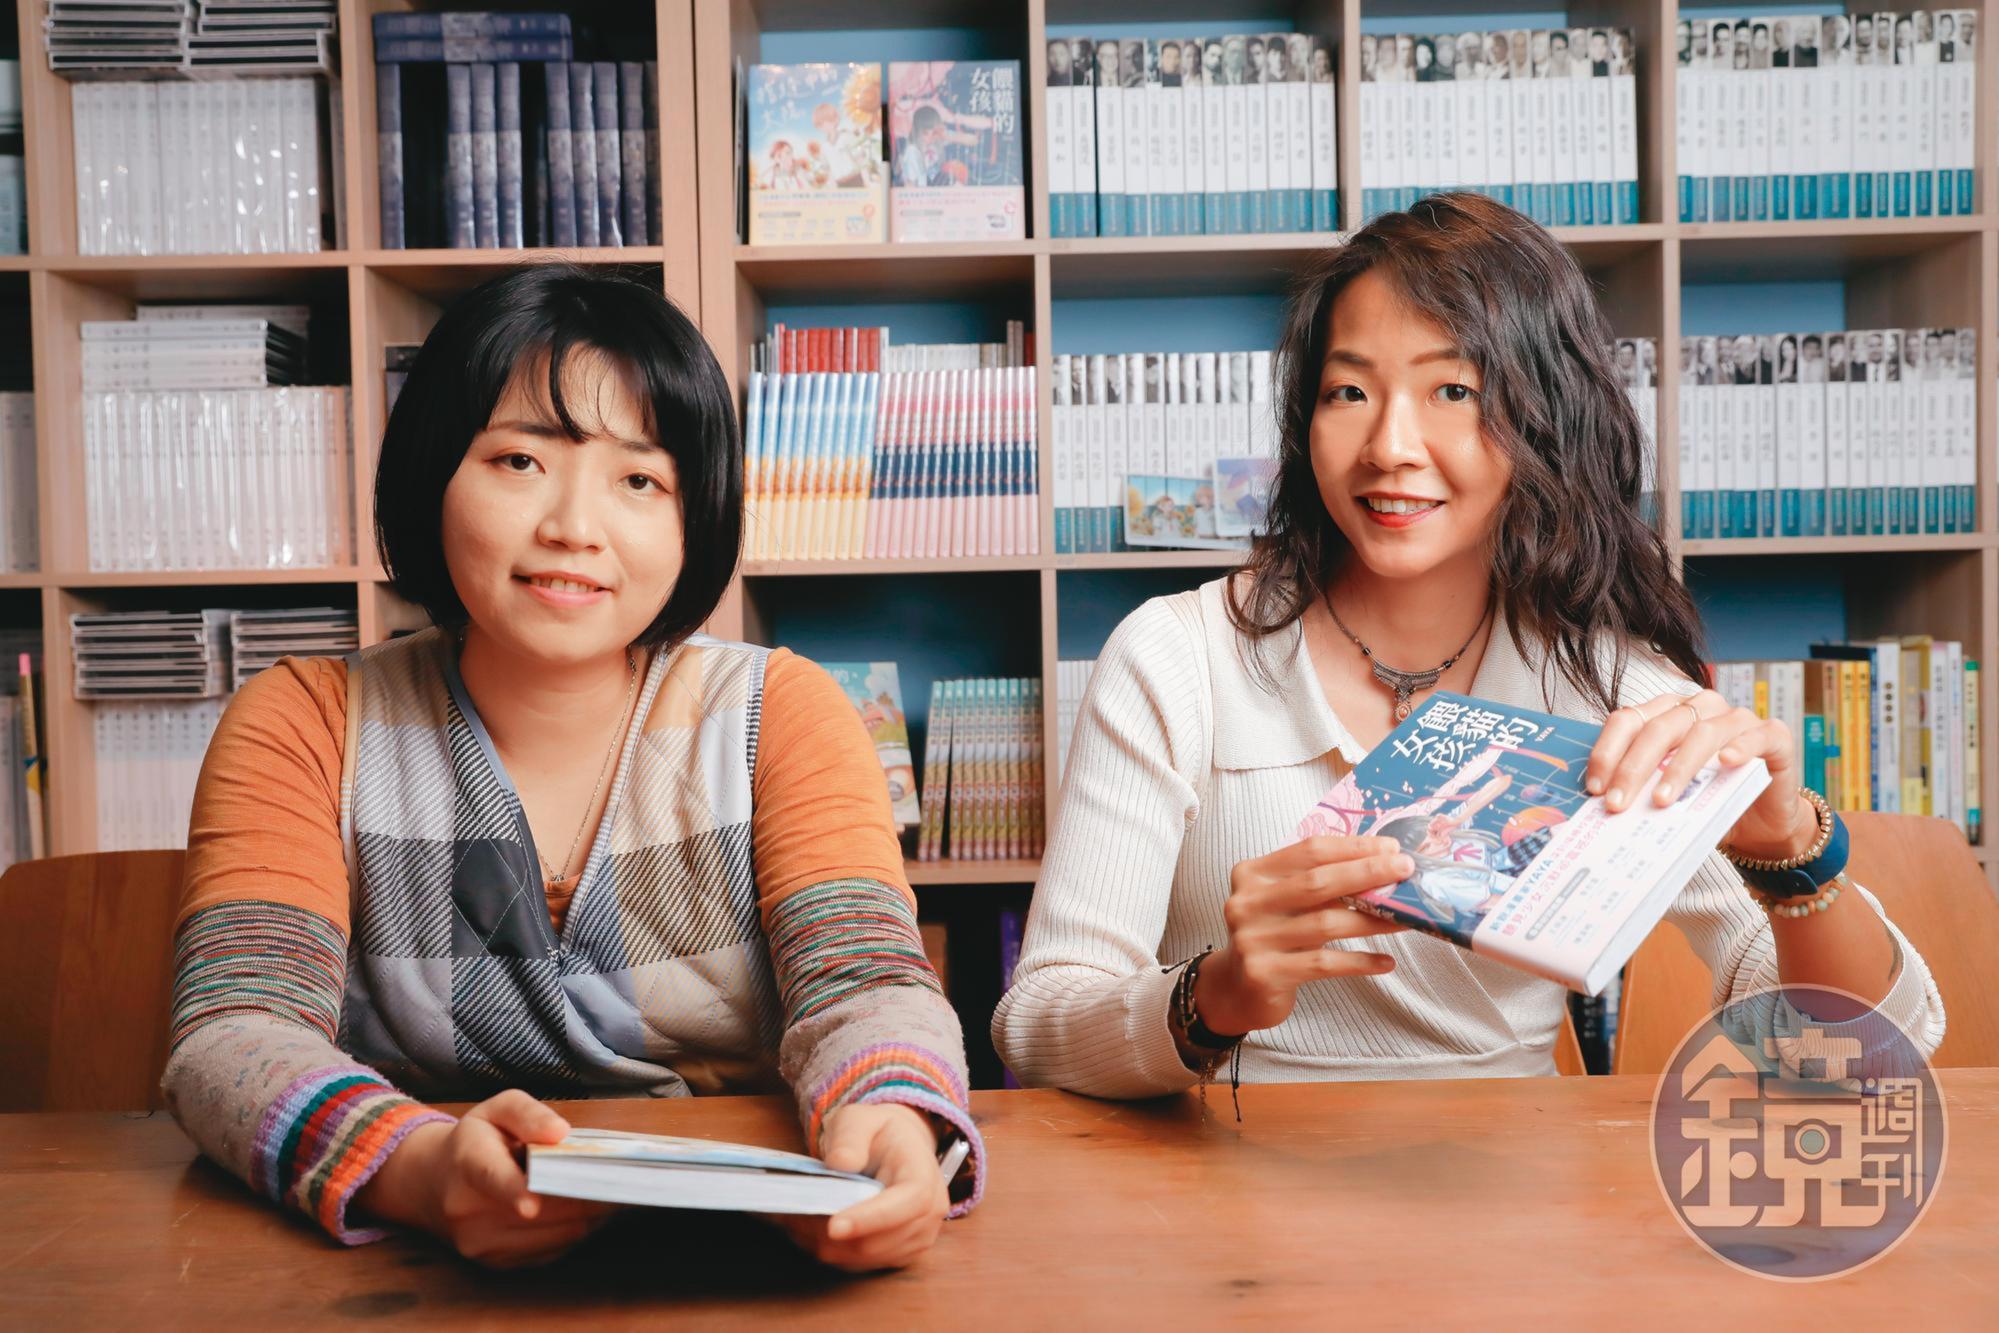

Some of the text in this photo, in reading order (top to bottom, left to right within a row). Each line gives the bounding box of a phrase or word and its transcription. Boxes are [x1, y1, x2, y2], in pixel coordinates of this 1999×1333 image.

[1417, 700, 1540, 751] 餵貓的
[1390, 729, 1477, 772] 女孩
